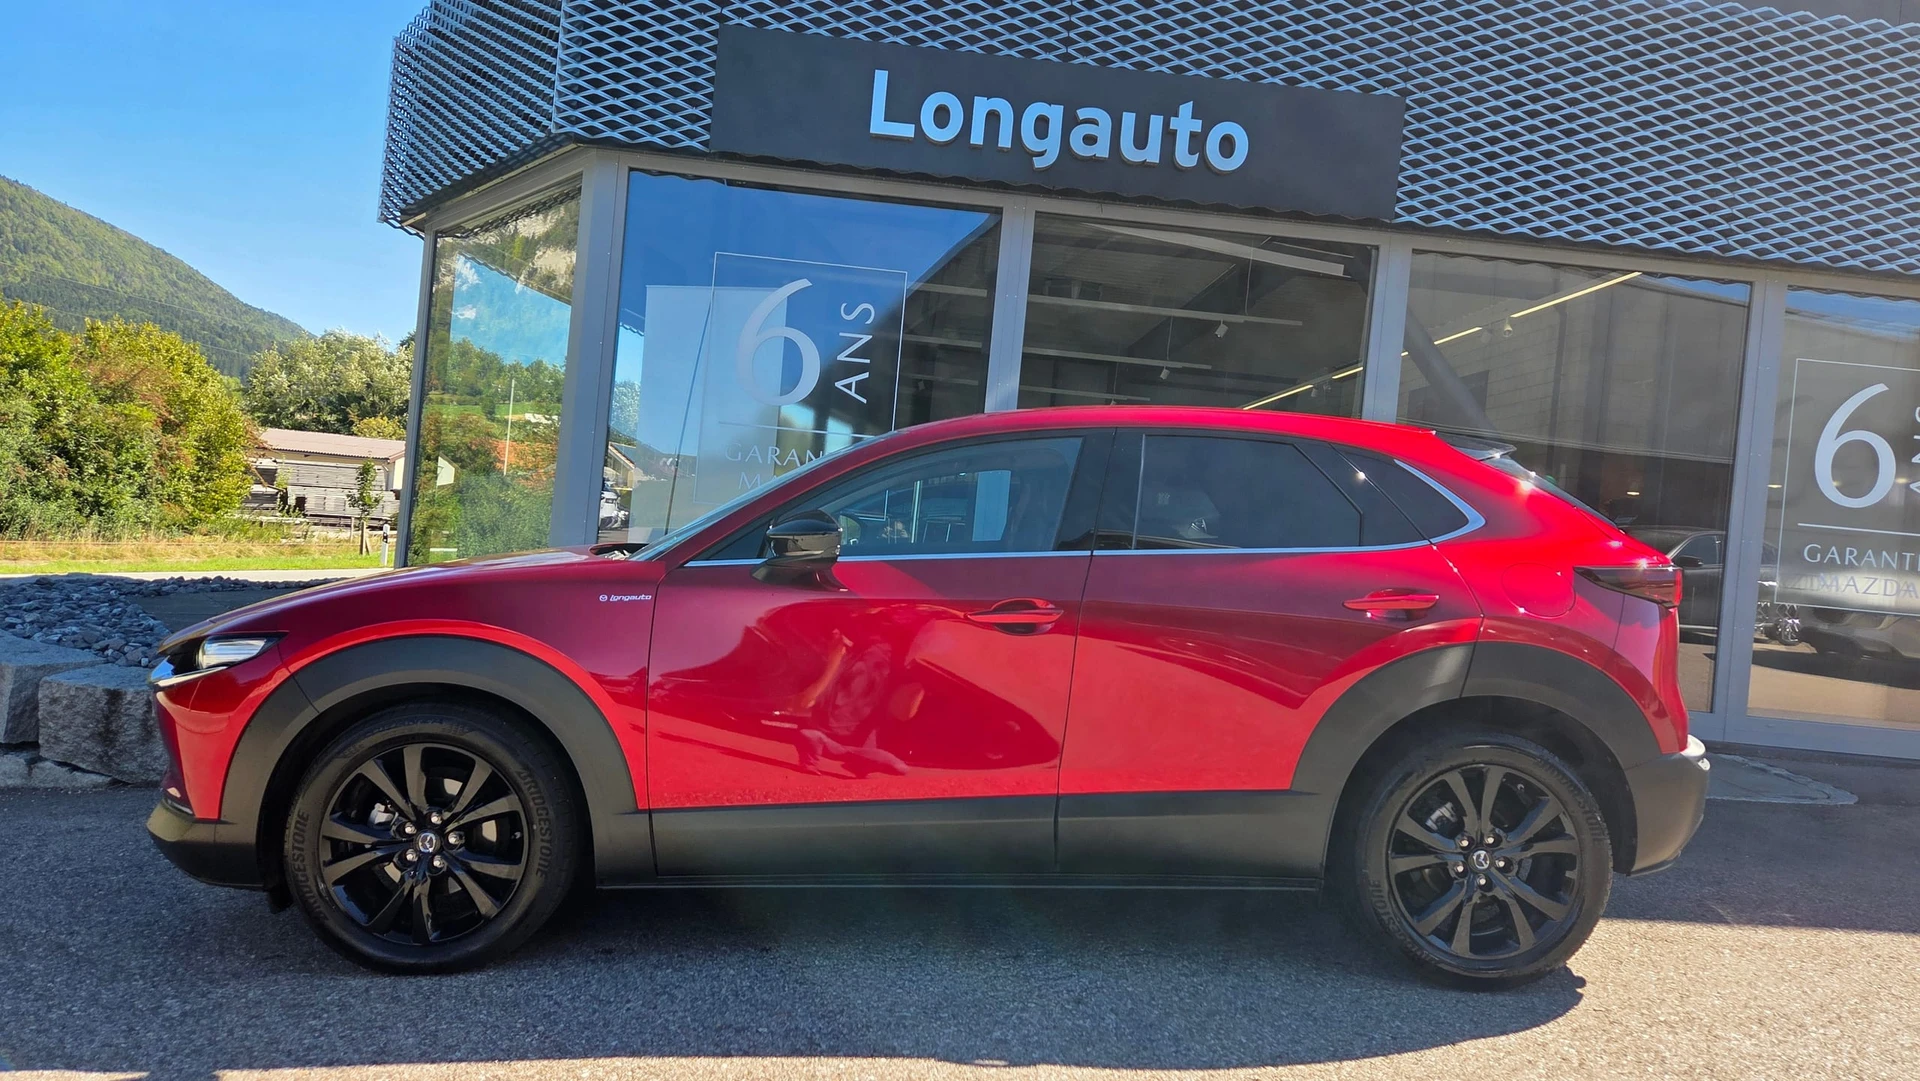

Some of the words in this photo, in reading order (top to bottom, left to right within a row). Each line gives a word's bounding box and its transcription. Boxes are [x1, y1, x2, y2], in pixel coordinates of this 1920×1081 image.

[869, 68, 1250, 173] Longauto
[735, 278, 821, 407] 6
[834, 302, 875, 405] ANS
[725, 442, 824, 467] GARAN
[1814, 382, 1897, 509] 6
[1803, 543, 1920, 572] GARANTI
[1818, 572, 1919, 599] MAZDA
